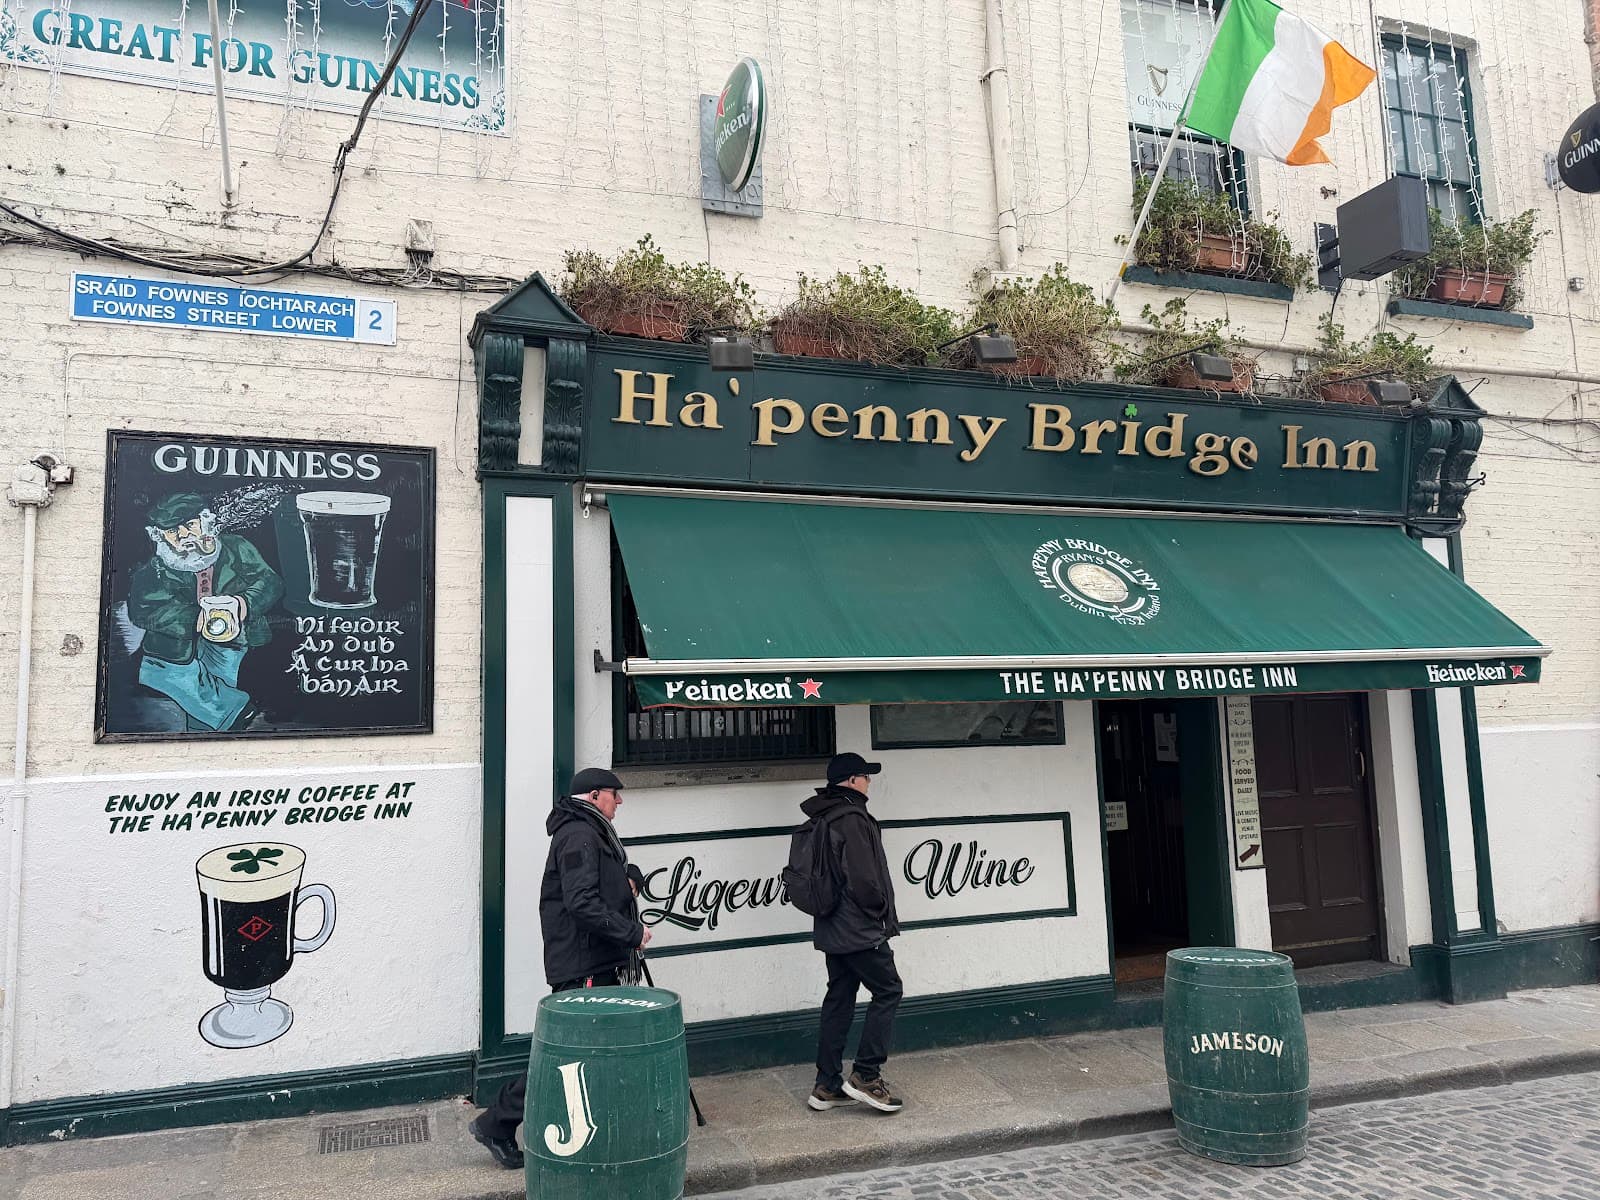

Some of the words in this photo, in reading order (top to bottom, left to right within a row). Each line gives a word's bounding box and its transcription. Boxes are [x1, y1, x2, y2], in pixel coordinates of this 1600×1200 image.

[31, 8, 182, 63] GREAT
[191, 32, 277, 79] FOR
[291, 48, 481, 110] GUINNESS
[1137, 94, 1183, 111] GUINNESS
[76, 278, 137, 299] SRÁID
[147, 286, 229, 306] FOWNES
[239, 290, 354, 317] ÍOCHTARACH
[92, 300, 176, 320] FOWNES
[187, 308, 260, 327] STREET
[271, 315, 337, 333] LOWER
[368, 309, 383, 331] 2
[1026, 403, 1259, 477] Bridge
[1280, 424, 1379, 473] Inn
[153, 443, 382, 482] GUINNESS
[1061, 553, 1105, 566] RYAN'S
[1065, 538, 1133, 568] BRIDGE
[1132, 569, 1161, 591] INN
[1059, 593, 1106, 617] Dublin
[1000, 672, 1045, 694] THE
[1053, 669, 1166, 693] HA'PENNY
[1176, 668, 1256, 690] BRIDGE
[1261, 667, 1298, 688] INN
[1425, 662, 1507, 683] Heineken
[104, 792, 180, 813] ENJOY
[186, 791, 221, 809] AN
[228, 787, 291, 807] IRISH
[298, 783, 379, 804] COFFEE
[385, 781, 416, 799] AT
[108, 814, 155, 834] THE
[161, 808, 277, 832] HA'PENNY
[284, 804, 367, 826] BRIDGE
[373, 801, 413, 820] INN
[903, 839, 1035, 900] Wine
[557, 996, 662, 1009] JAMESON
[1190, 1031, 1284, 1058] JAMESON
[544, 1061, 598, 1157] J
